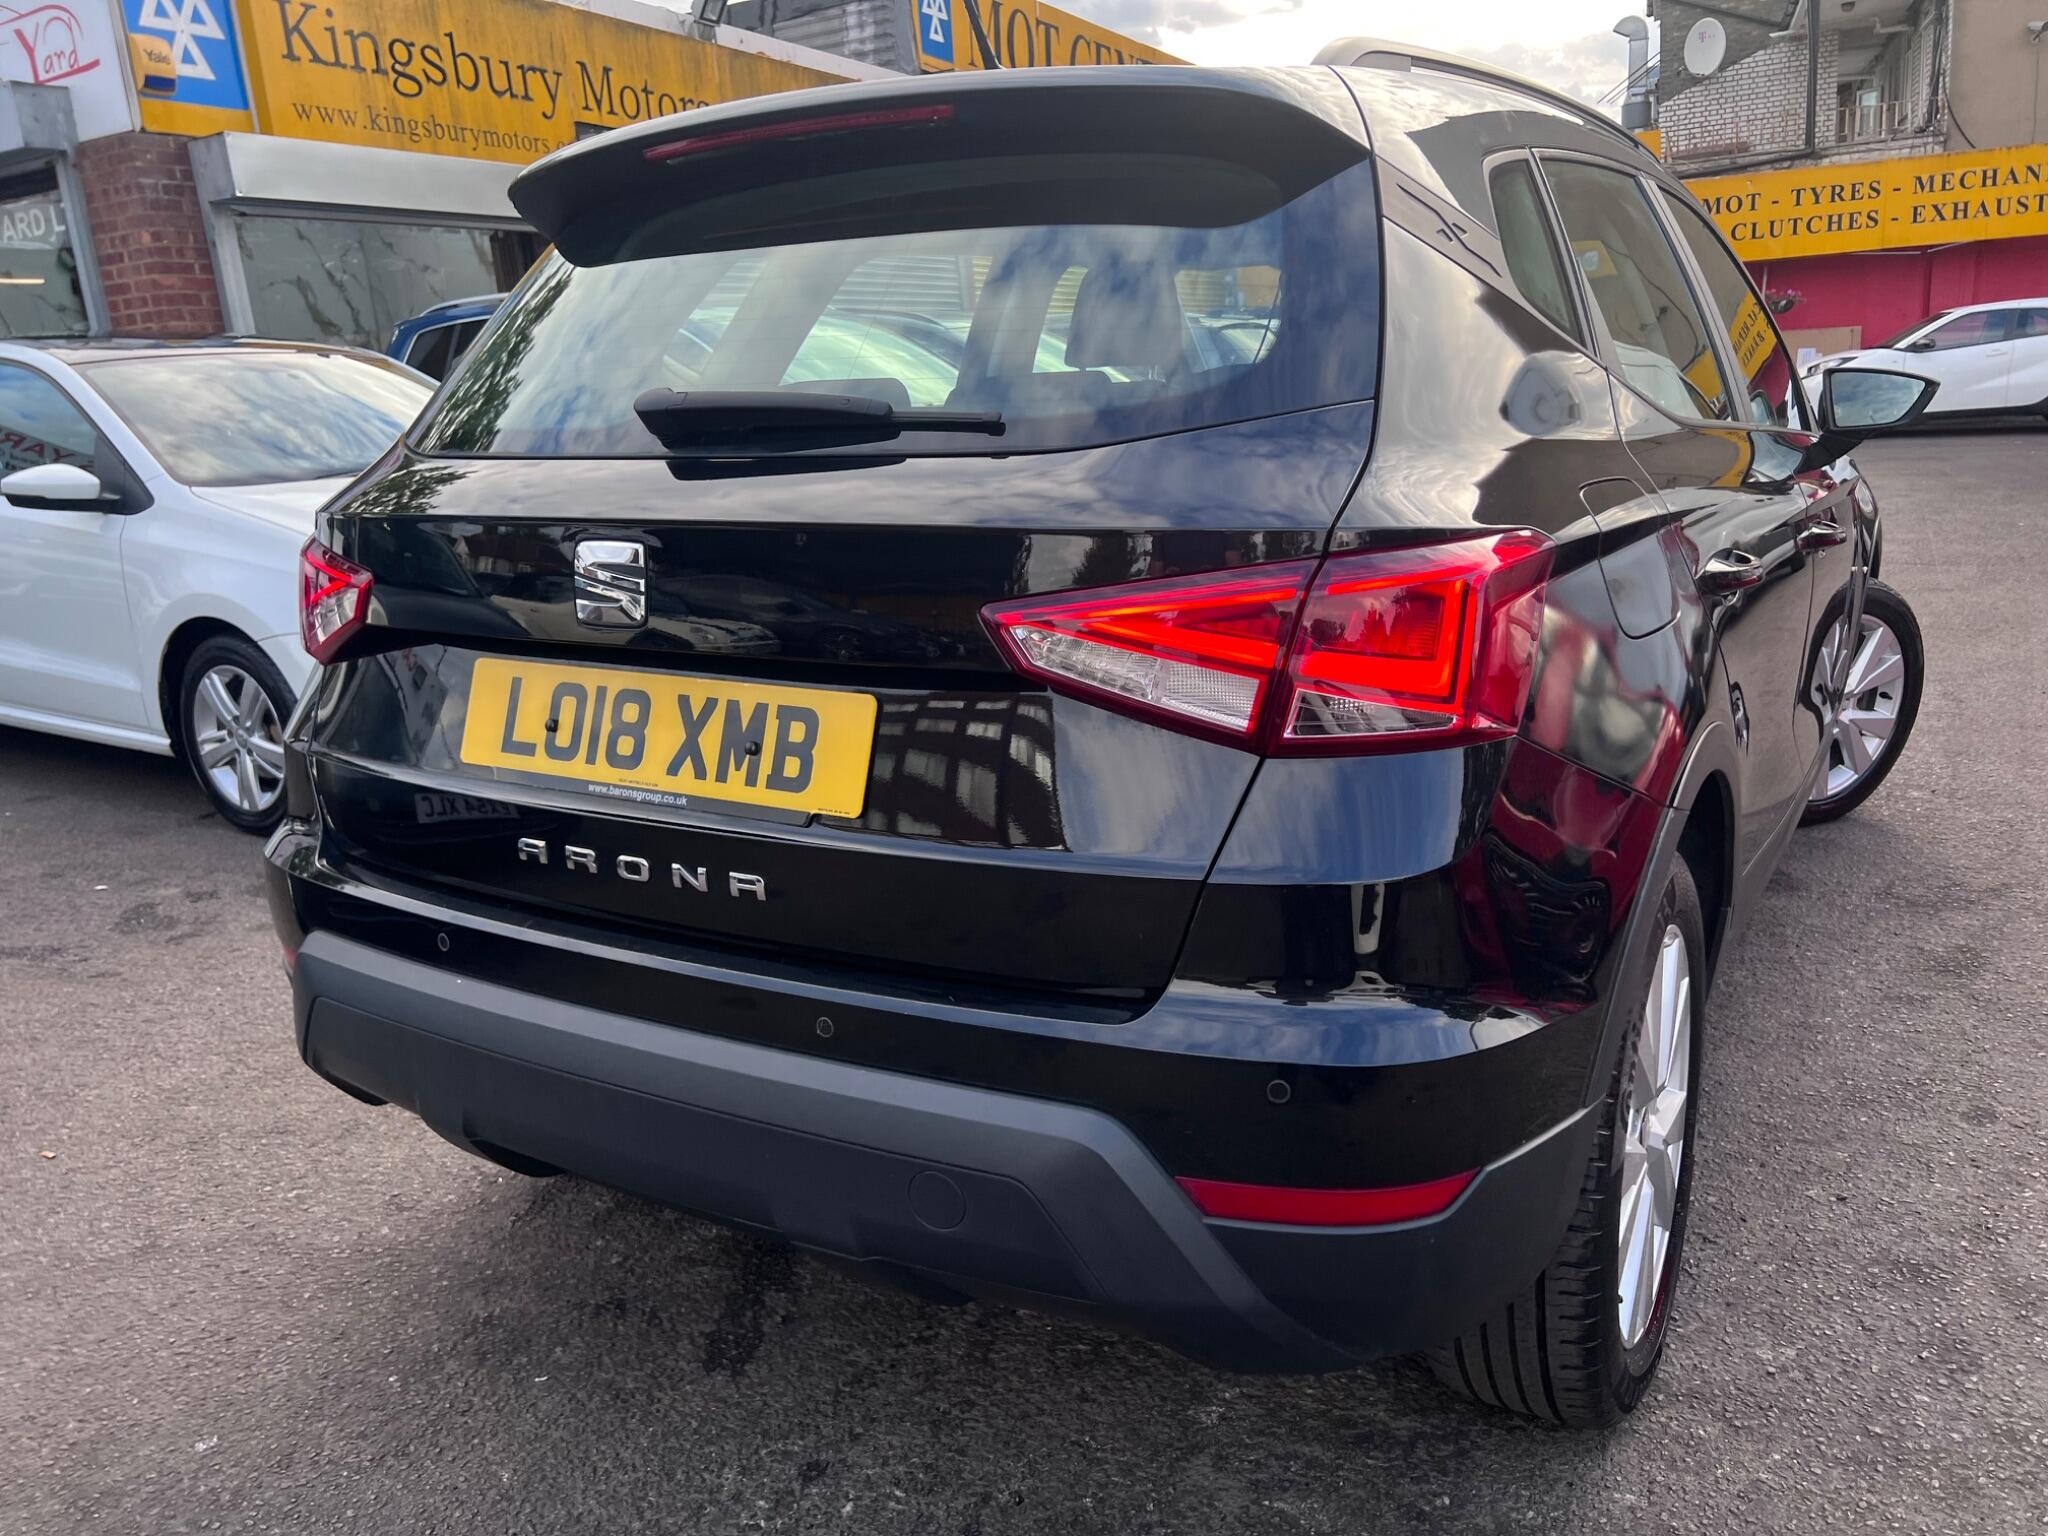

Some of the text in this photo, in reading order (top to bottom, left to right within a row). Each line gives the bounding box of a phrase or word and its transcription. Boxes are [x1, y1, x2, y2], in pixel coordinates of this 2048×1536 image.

[14, 17, 100, 85] Yard
[272, 0, 563, 120] Kingsbury
[1702, 193, 1761, 216] MOT
[1791, 180, 1881, 208] TYRES
[1912, 163, 2048, 194] MECHAN
[1730, 210, 1880, 242] CLUTCHES
[1911, 193, 2048, 225] EXHAUST
[500, 676, 820, 794] LO18 XMB
[587, 783, 688, 806] www.baronsgroup.co.uk
[517, 837, 767, 901] ARONA
